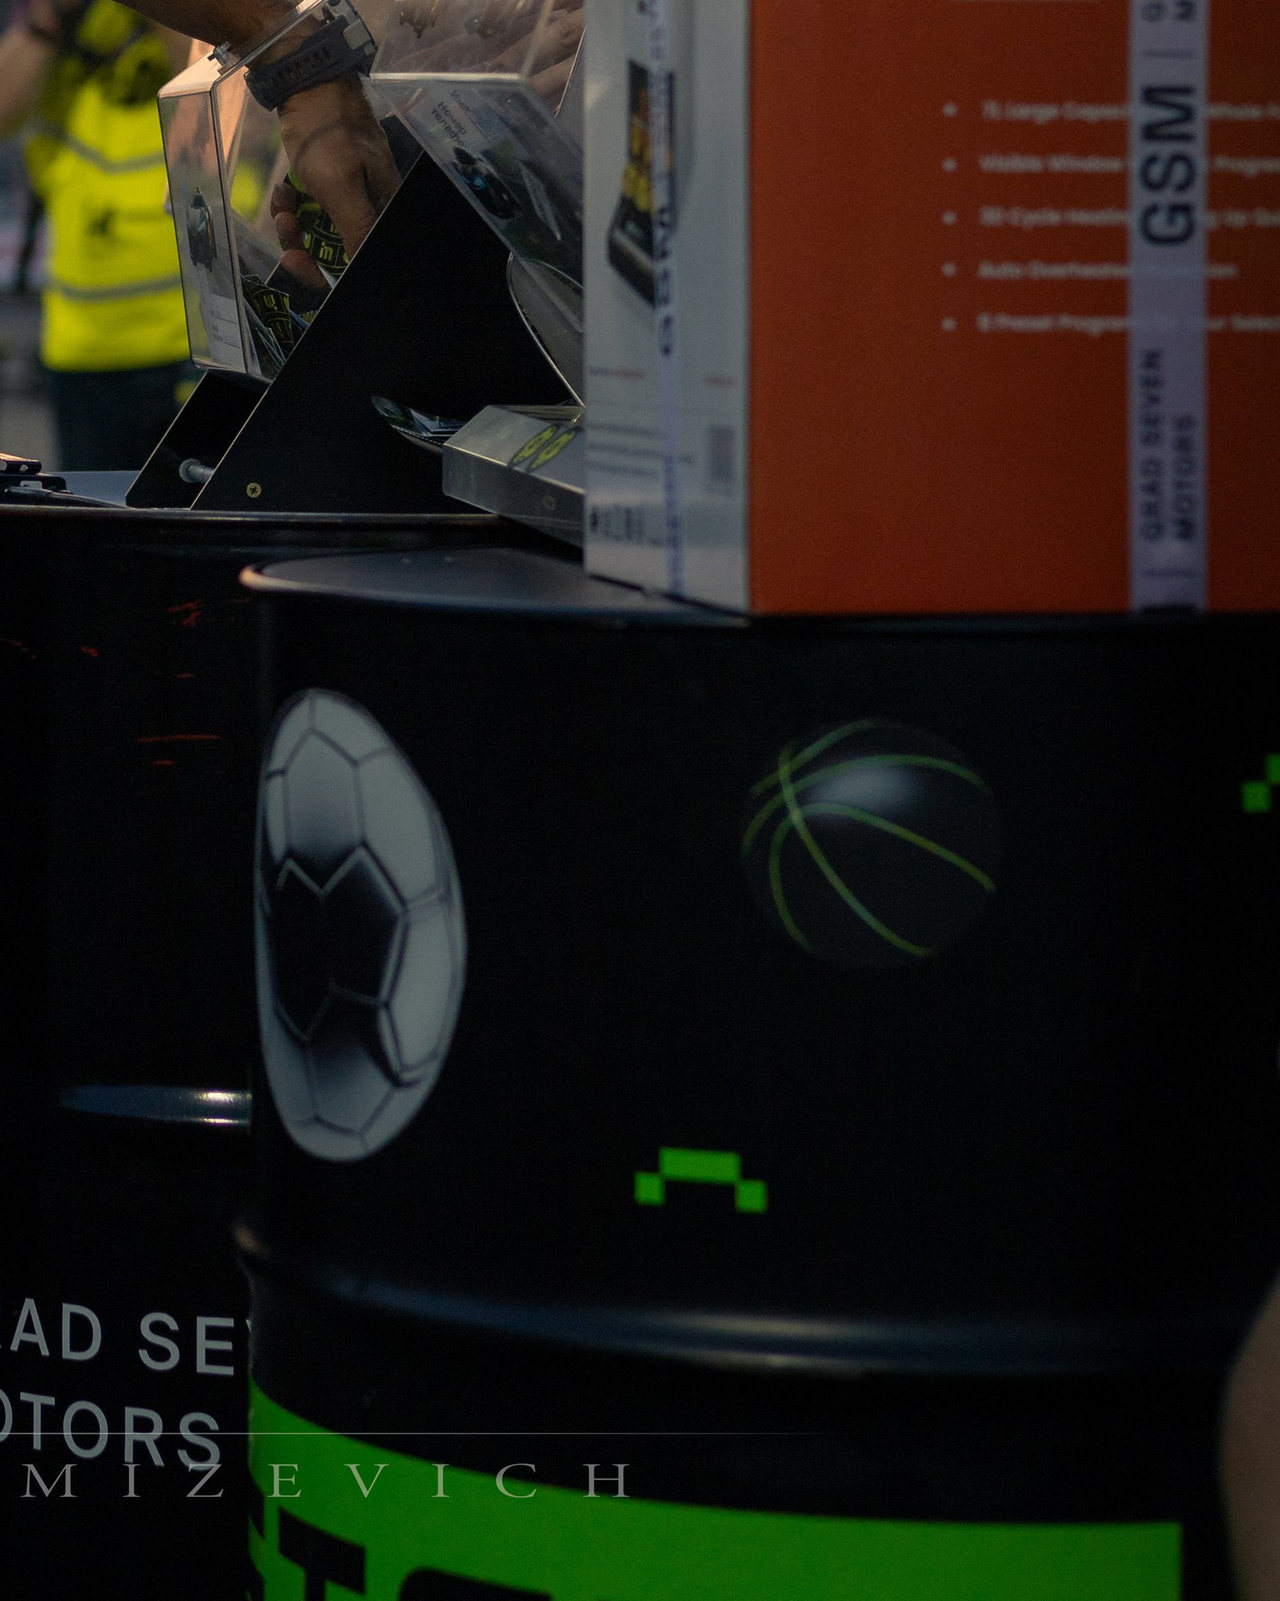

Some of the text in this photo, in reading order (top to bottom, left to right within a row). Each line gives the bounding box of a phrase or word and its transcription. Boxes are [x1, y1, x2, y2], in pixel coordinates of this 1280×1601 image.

[431, 107, 465, 146] телефо
[438, 101, 467, 135] Номер
[1140, 85, 1196, 246] GSM
[1140, 350, 1164, 541] GRAD SEVEN
[1171, 415, 1197, 542] MOTORS
[138, 1311, 252, 1376] SE
